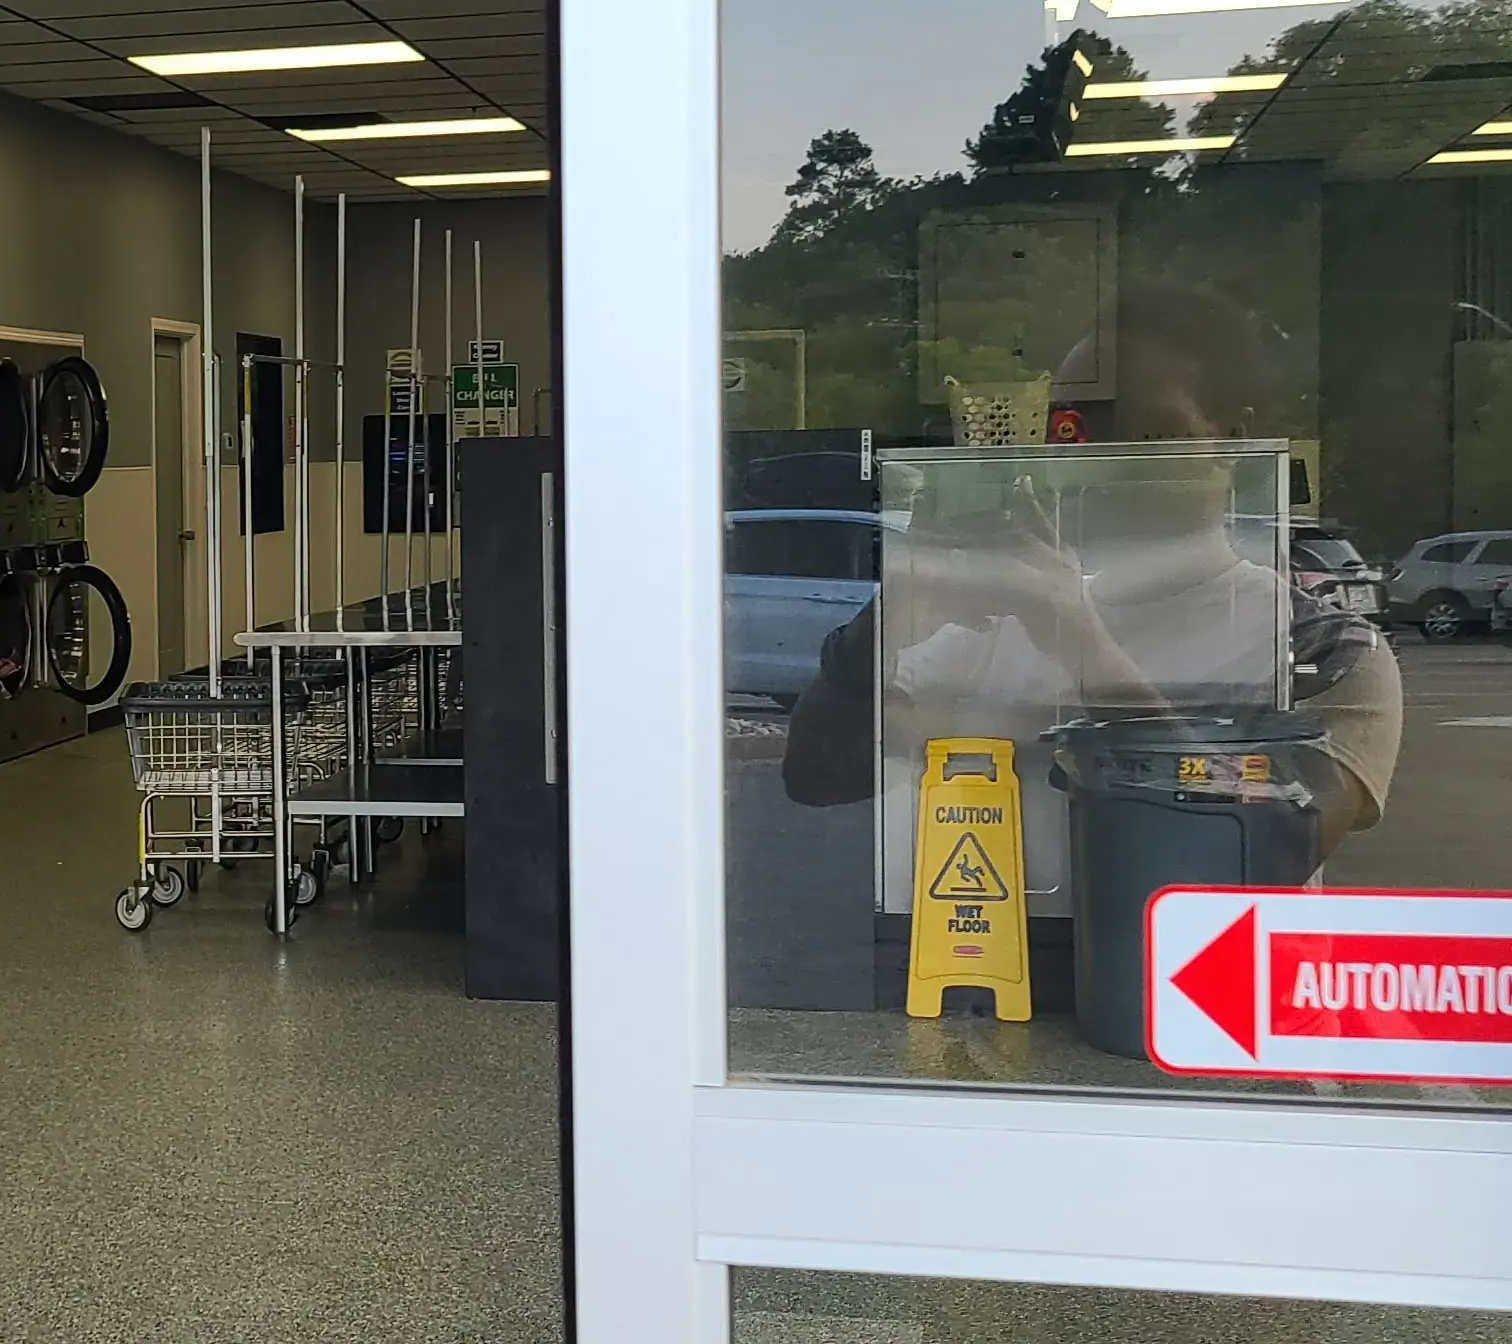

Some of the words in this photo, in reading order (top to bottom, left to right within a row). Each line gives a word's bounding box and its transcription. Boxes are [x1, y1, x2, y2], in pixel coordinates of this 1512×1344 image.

[935, 806, 1003, 824] CAUTION
[954, 904, 983, 918] WET
[948, 919, 991, 933] FLOOR
